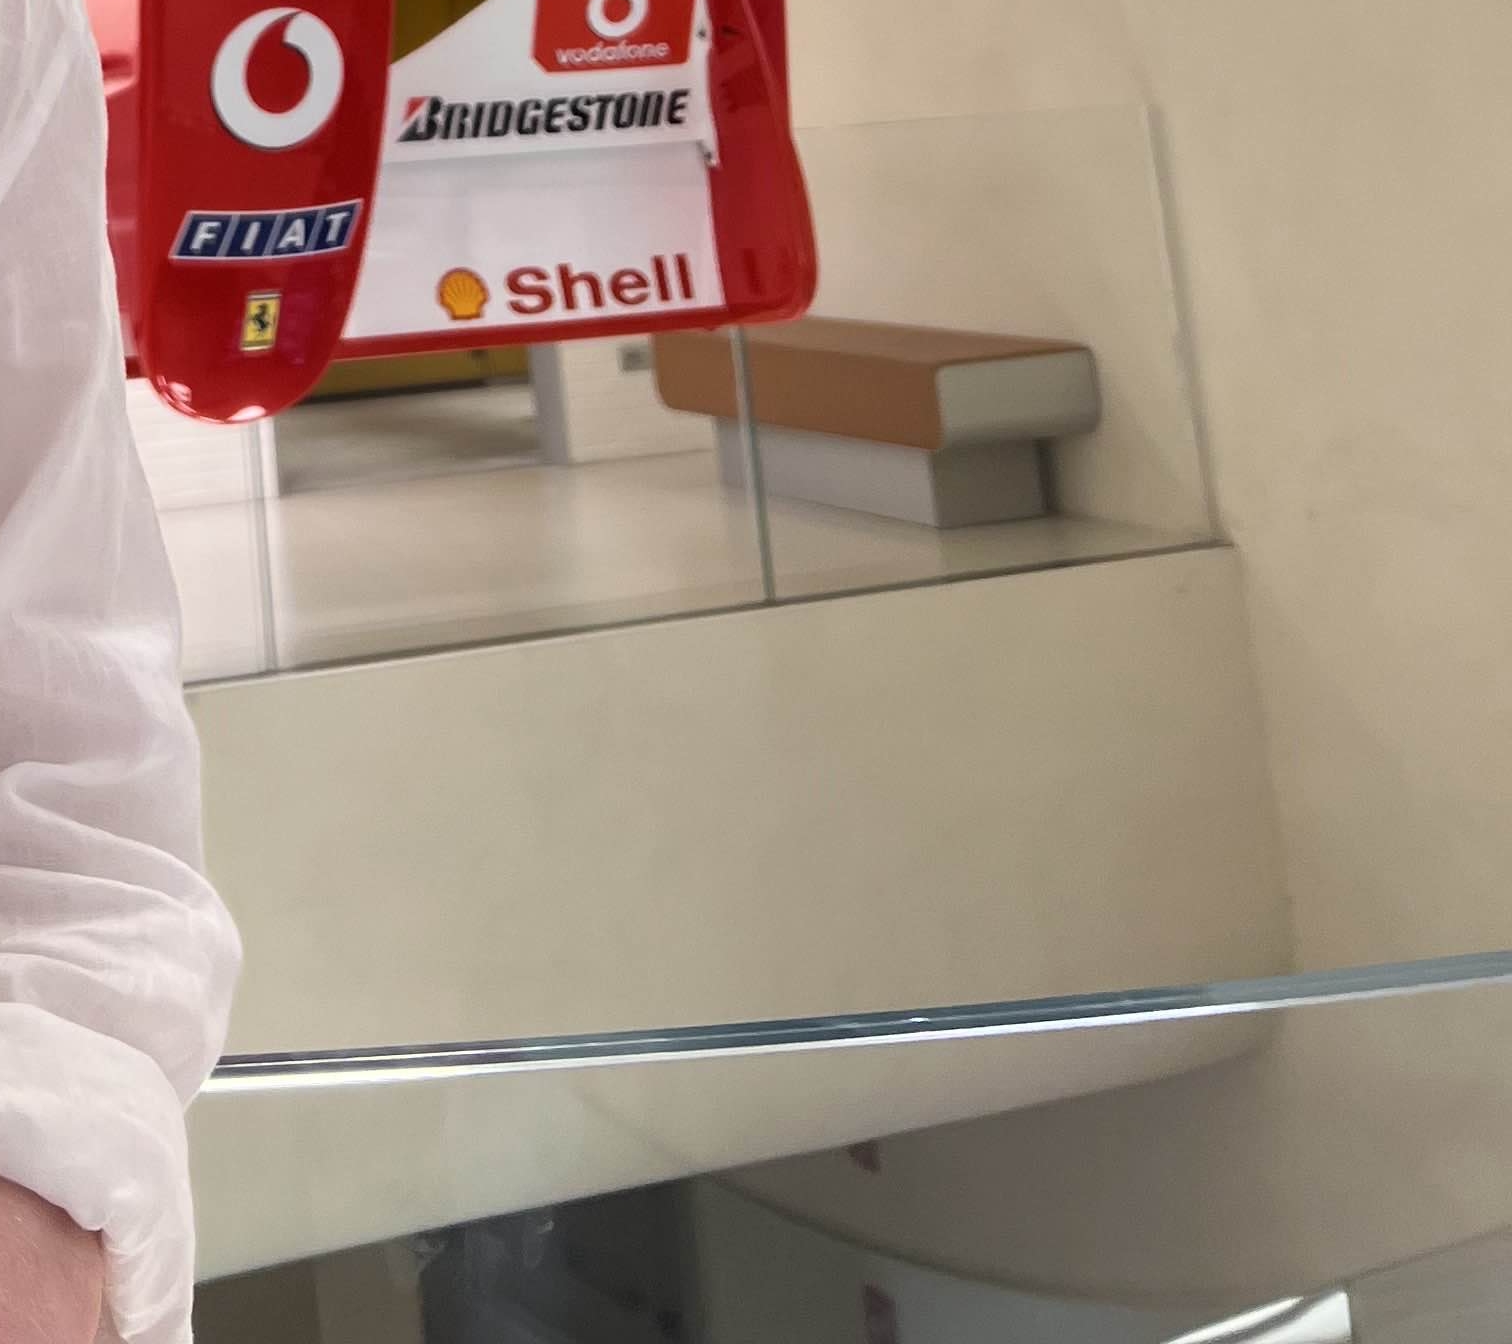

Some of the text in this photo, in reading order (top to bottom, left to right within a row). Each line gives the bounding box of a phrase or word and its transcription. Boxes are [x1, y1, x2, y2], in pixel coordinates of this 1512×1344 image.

[554, 39, 670, 66] vodafone
[397, 88, 691, 142] BRIDGESTONE
[190, 211, 351, 251] FIAT
[505, 253, 695, 315] Shell
